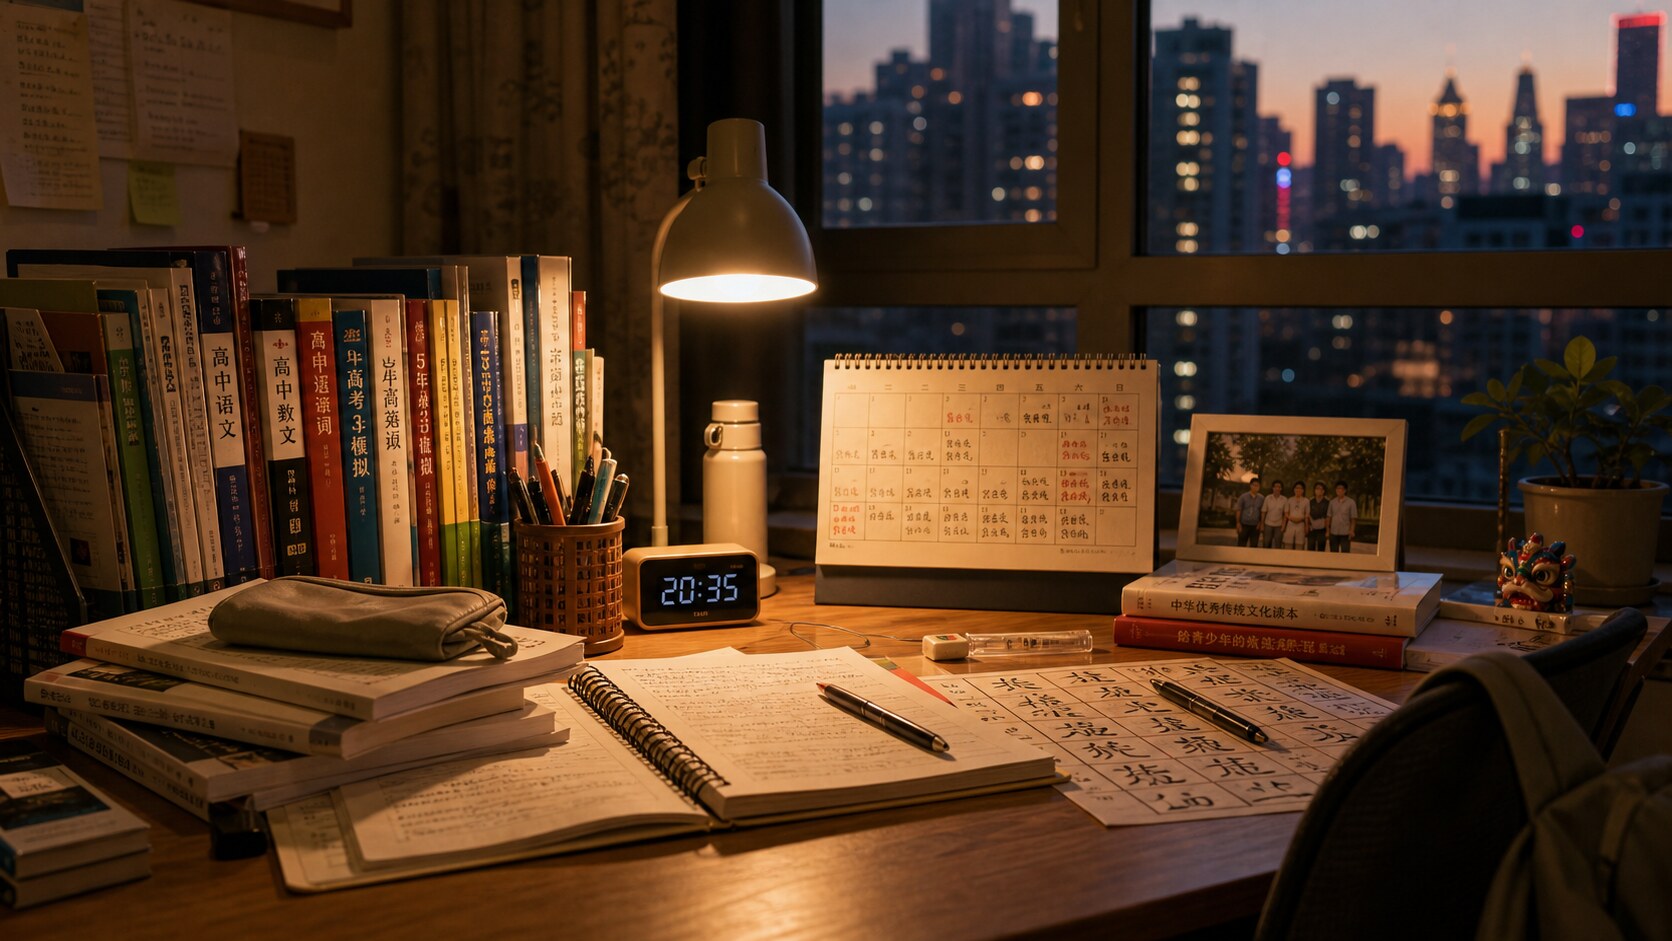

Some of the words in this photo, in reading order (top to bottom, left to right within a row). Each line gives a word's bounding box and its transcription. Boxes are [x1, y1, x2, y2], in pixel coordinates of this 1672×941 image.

[211, 346, 236, 440] 高中语文
[958, 383, 967, 392] 三
[1074, 383, 1084, 392] 六
[1115, 383, 1124, 392] 日
[661, 573, 738, 606] 20:35
